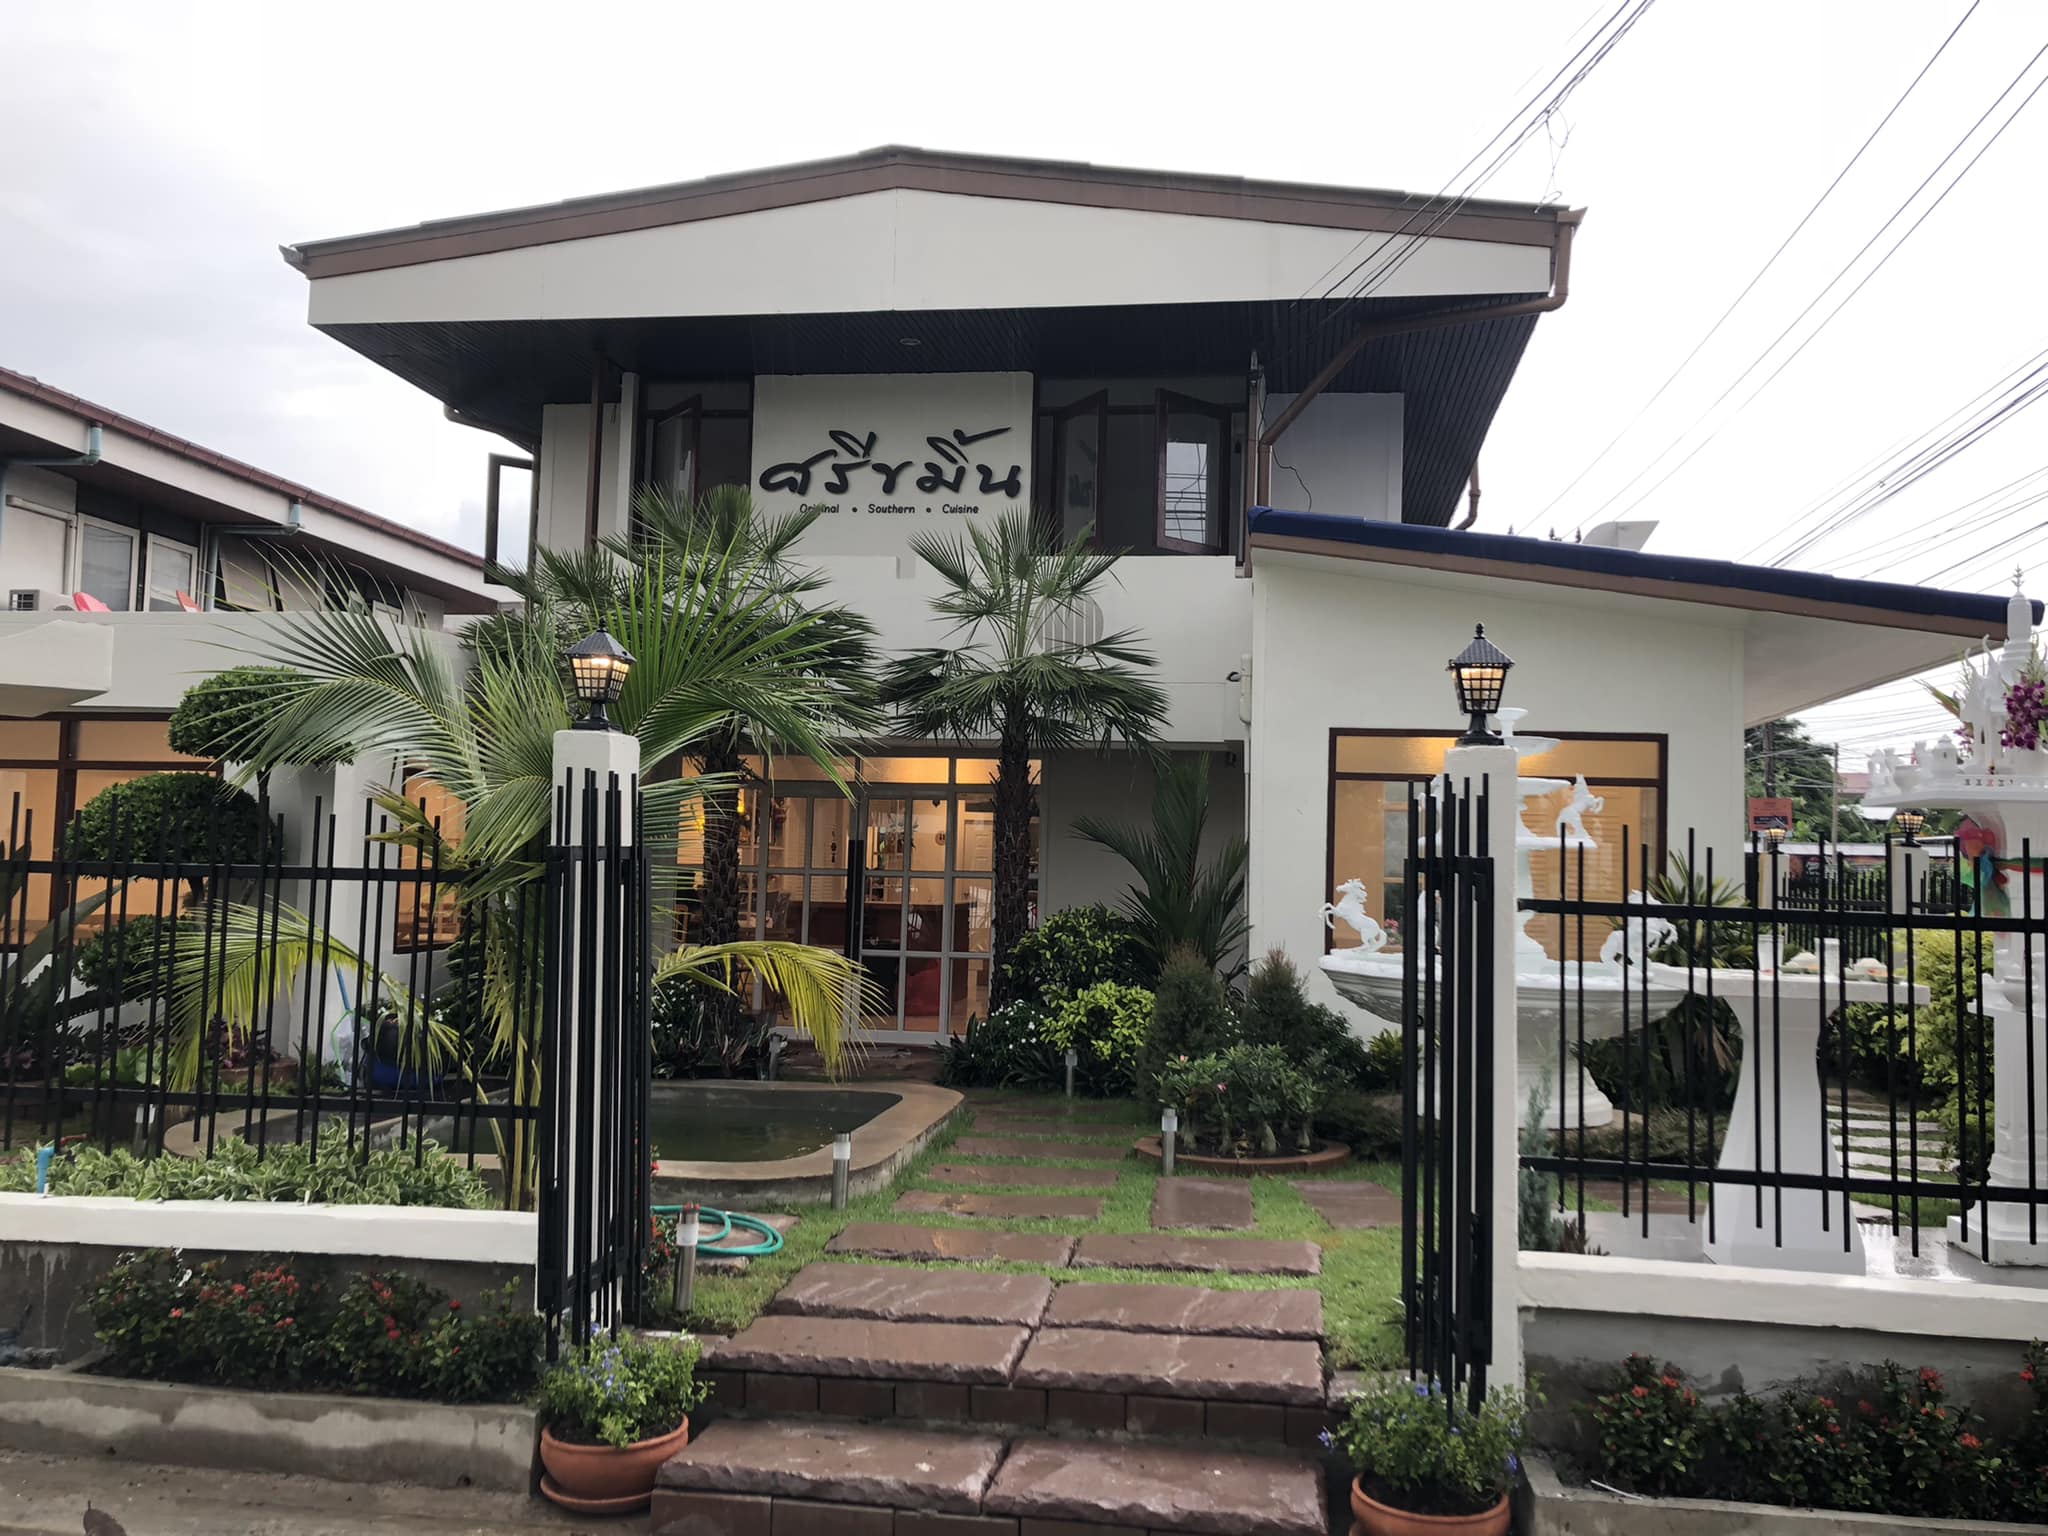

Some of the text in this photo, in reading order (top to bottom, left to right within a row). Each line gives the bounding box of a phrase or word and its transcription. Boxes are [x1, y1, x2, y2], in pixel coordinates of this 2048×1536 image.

[799, 503, 979, 515] Oriinal Southern Cuisine
